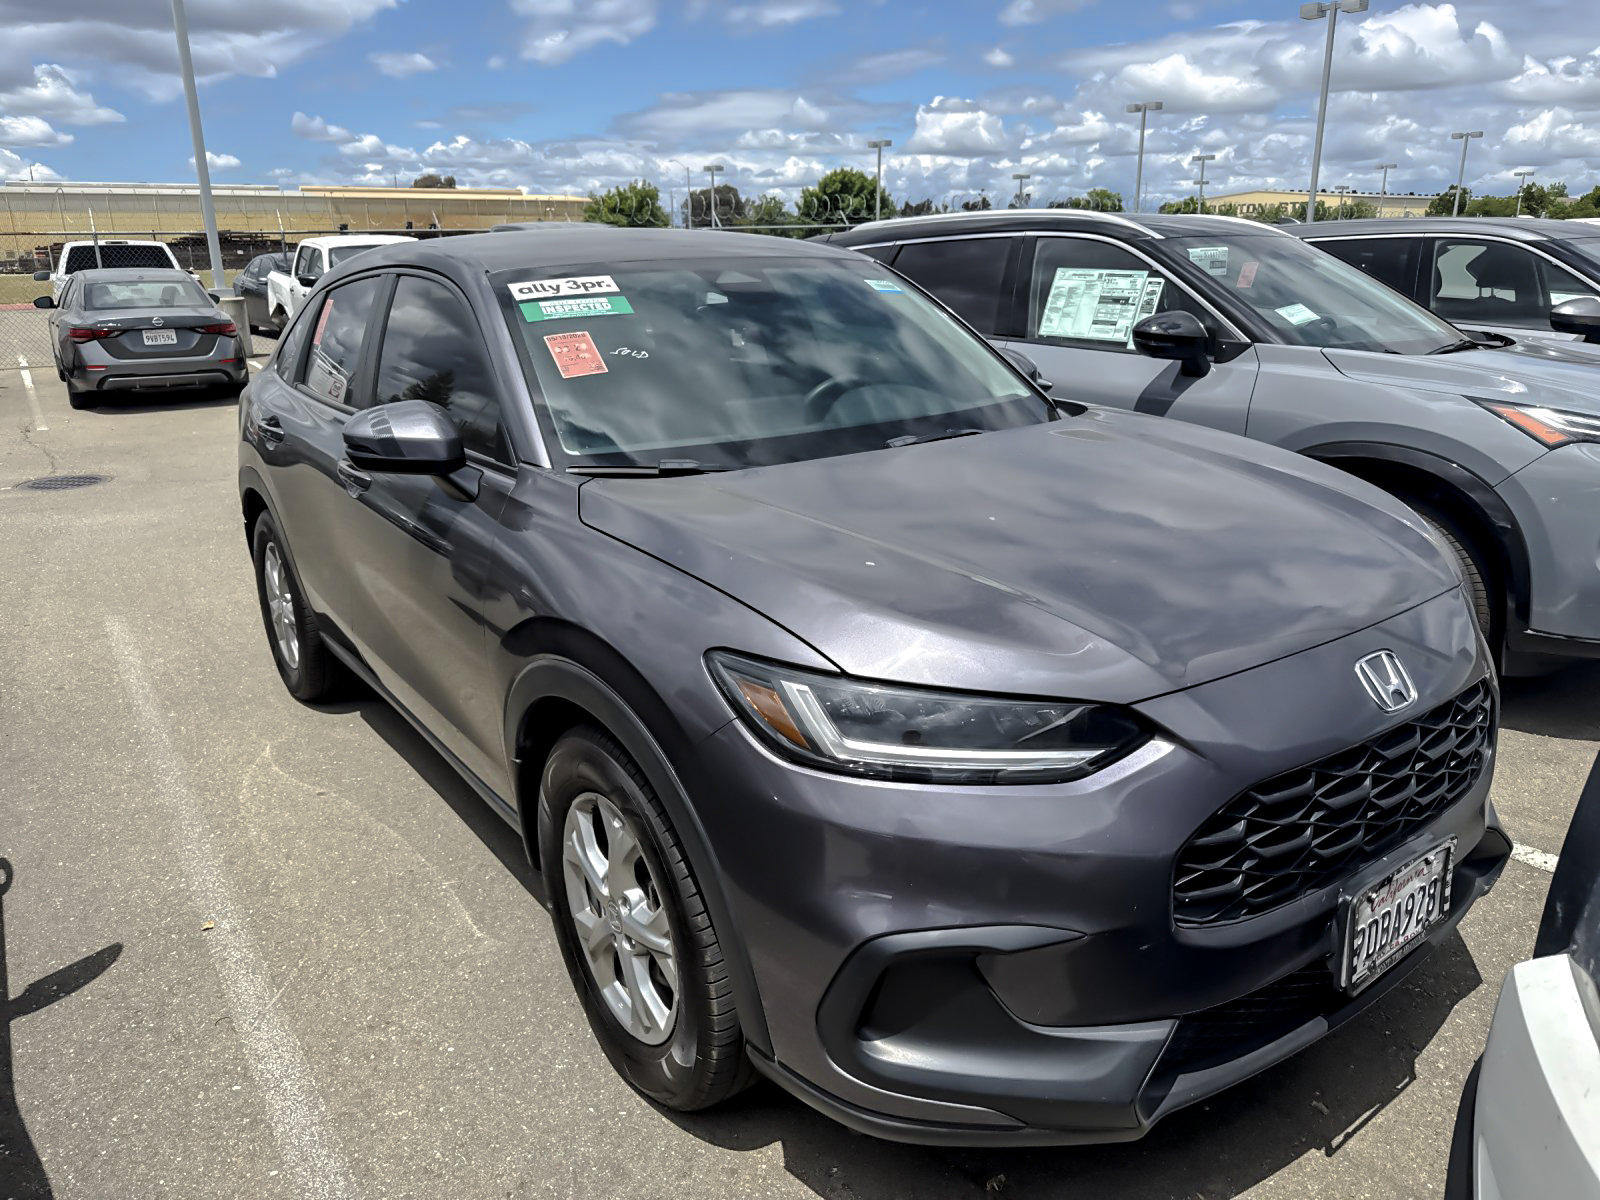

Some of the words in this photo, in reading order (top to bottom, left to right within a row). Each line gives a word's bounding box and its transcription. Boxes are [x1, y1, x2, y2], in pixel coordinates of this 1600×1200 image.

[518, 283, 561, 294] ally
[542, 302, 612, 314] INSPECTED
[1370, 868, 1430, 912] California
